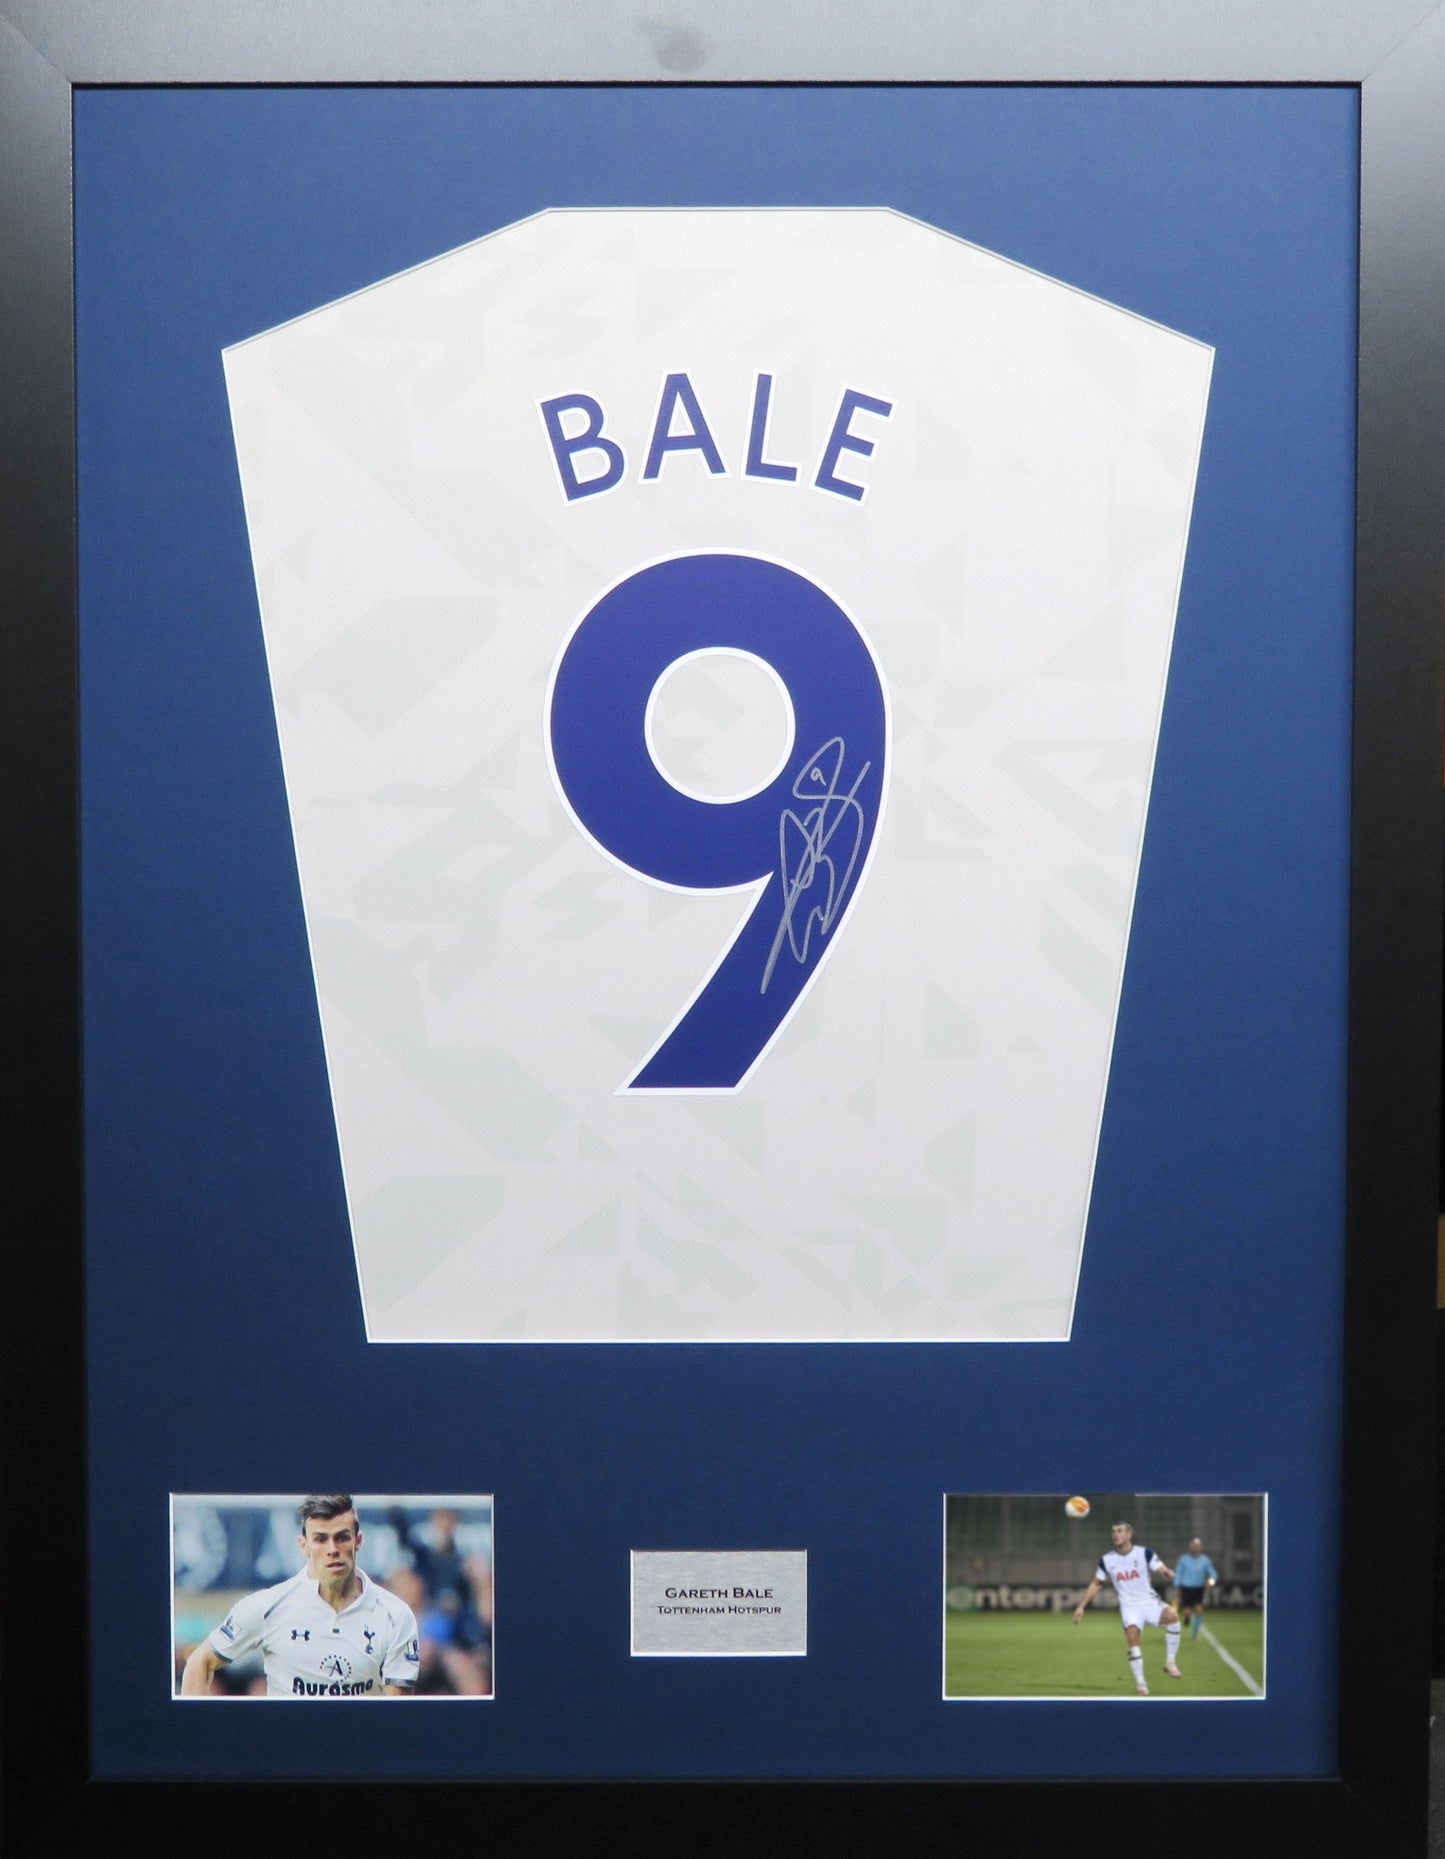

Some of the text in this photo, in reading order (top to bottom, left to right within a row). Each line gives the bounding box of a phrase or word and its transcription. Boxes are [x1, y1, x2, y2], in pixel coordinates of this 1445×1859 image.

[538, 371, 895, 504] BALE
[547, 550, 888, 1092] 9
[1116, 1569, 1140, 1582] AIA
[665, 1587, 774, 1599] GARETH BALE
[657, 1605, 782, 1615] TOTTENHAM HOTSPUR
